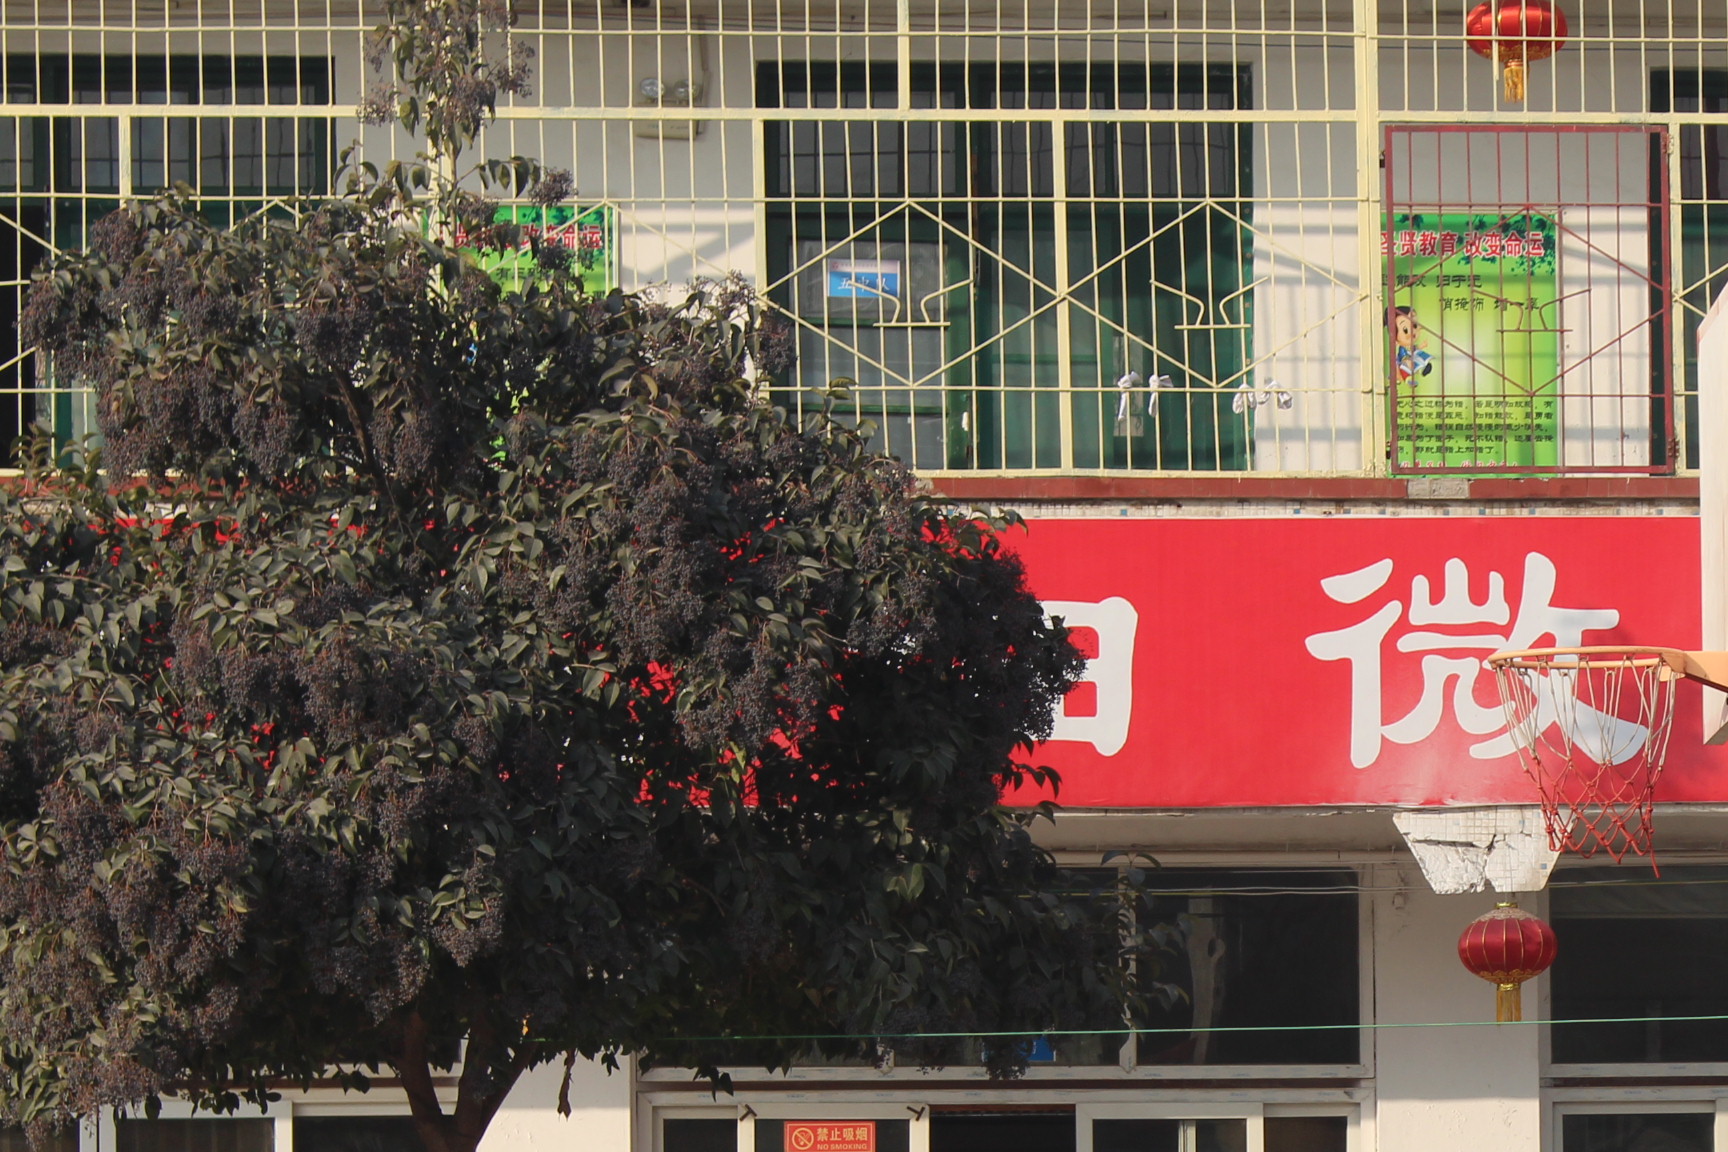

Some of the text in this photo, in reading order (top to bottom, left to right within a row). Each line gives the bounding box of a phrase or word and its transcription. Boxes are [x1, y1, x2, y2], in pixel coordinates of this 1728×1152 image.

[1464, 231, 1545, 257] 改变命运
[817, 1127, 868, 1142] 禁止吸烟
[817, 1143, 868, 1151] NO SMOKING
